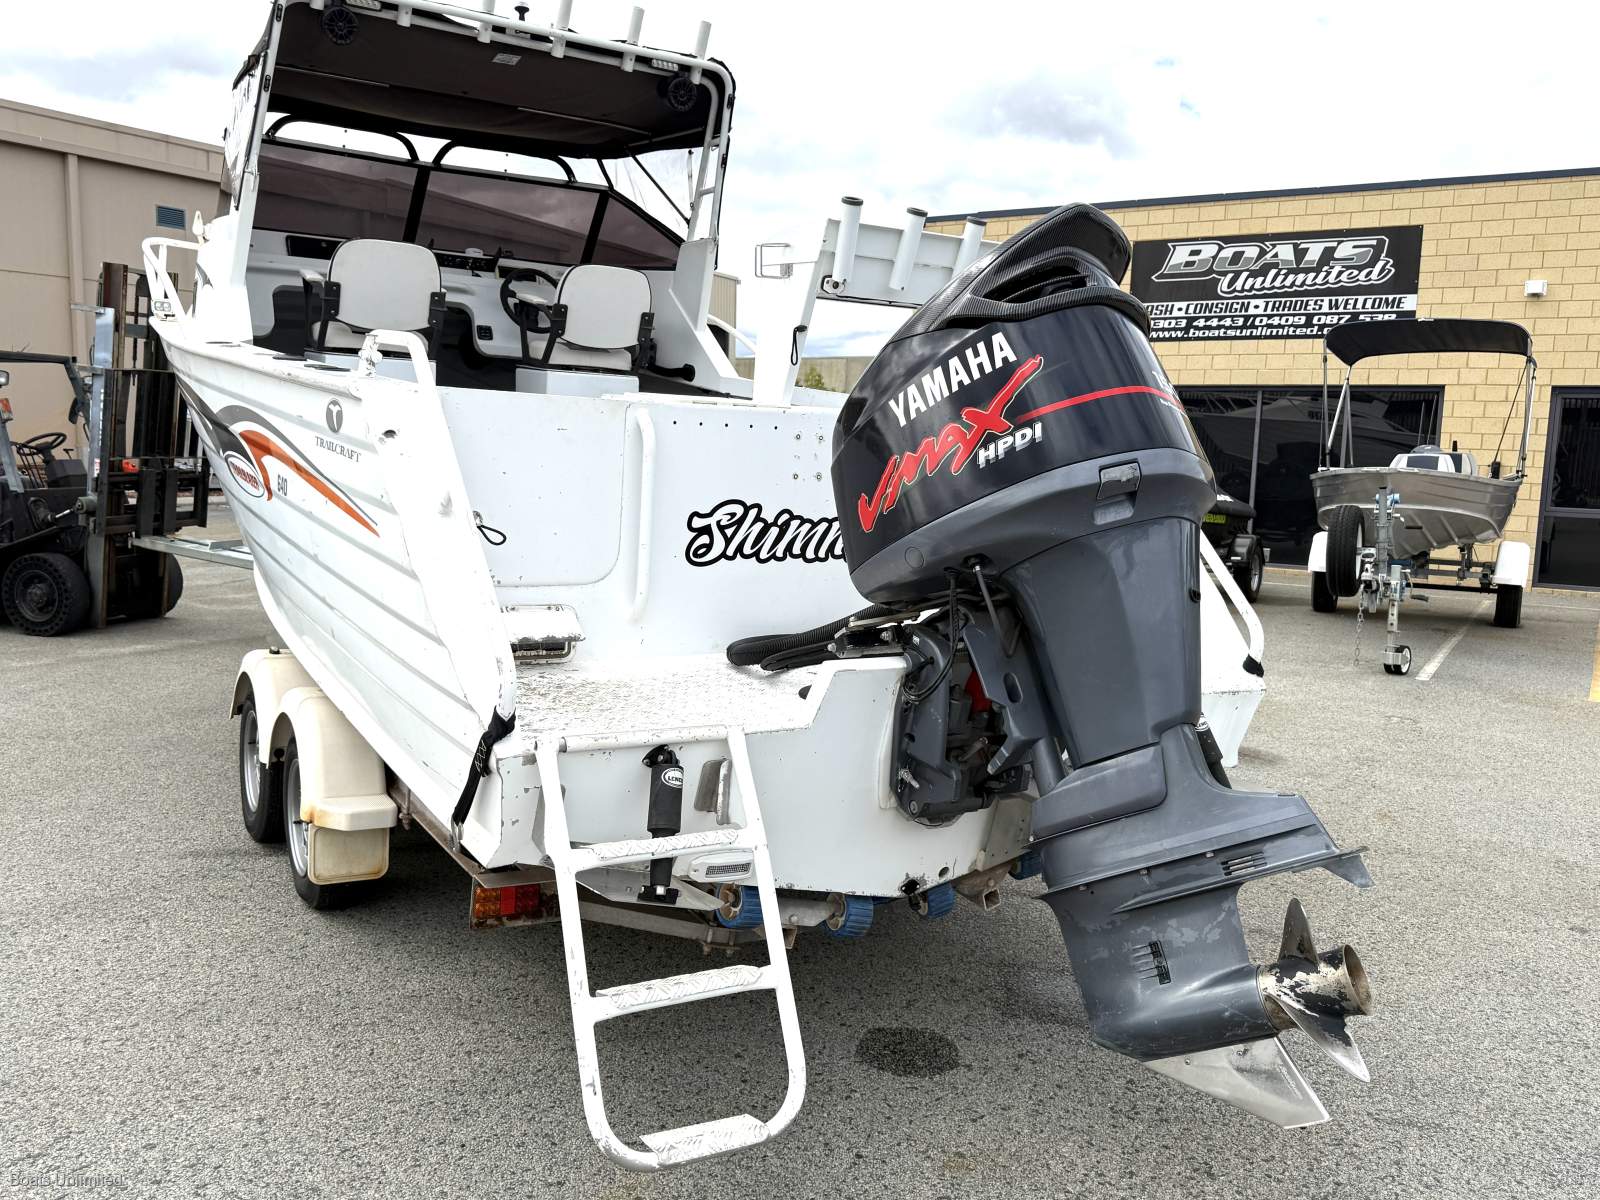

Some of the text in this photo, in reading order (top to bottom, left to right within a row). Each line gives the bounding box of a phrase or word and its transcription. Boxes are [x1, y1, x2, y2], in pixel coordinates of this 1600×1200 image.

[1164, 239, 1378, 274] BOATS
[1219, 258, 1393, 294] Unlimited
[1145, 296, 1408, 317] ASH CONSIGN TRADES WELCOME
[1150, 318, 1187, 329] 303
[1312, 314, 1352, 325] 087
[888, 331, 1018, 428] YAMAHA
[315, 435, 362, 463] TRAILCRAFT
[976, 421, 1042, 470] HPDI
